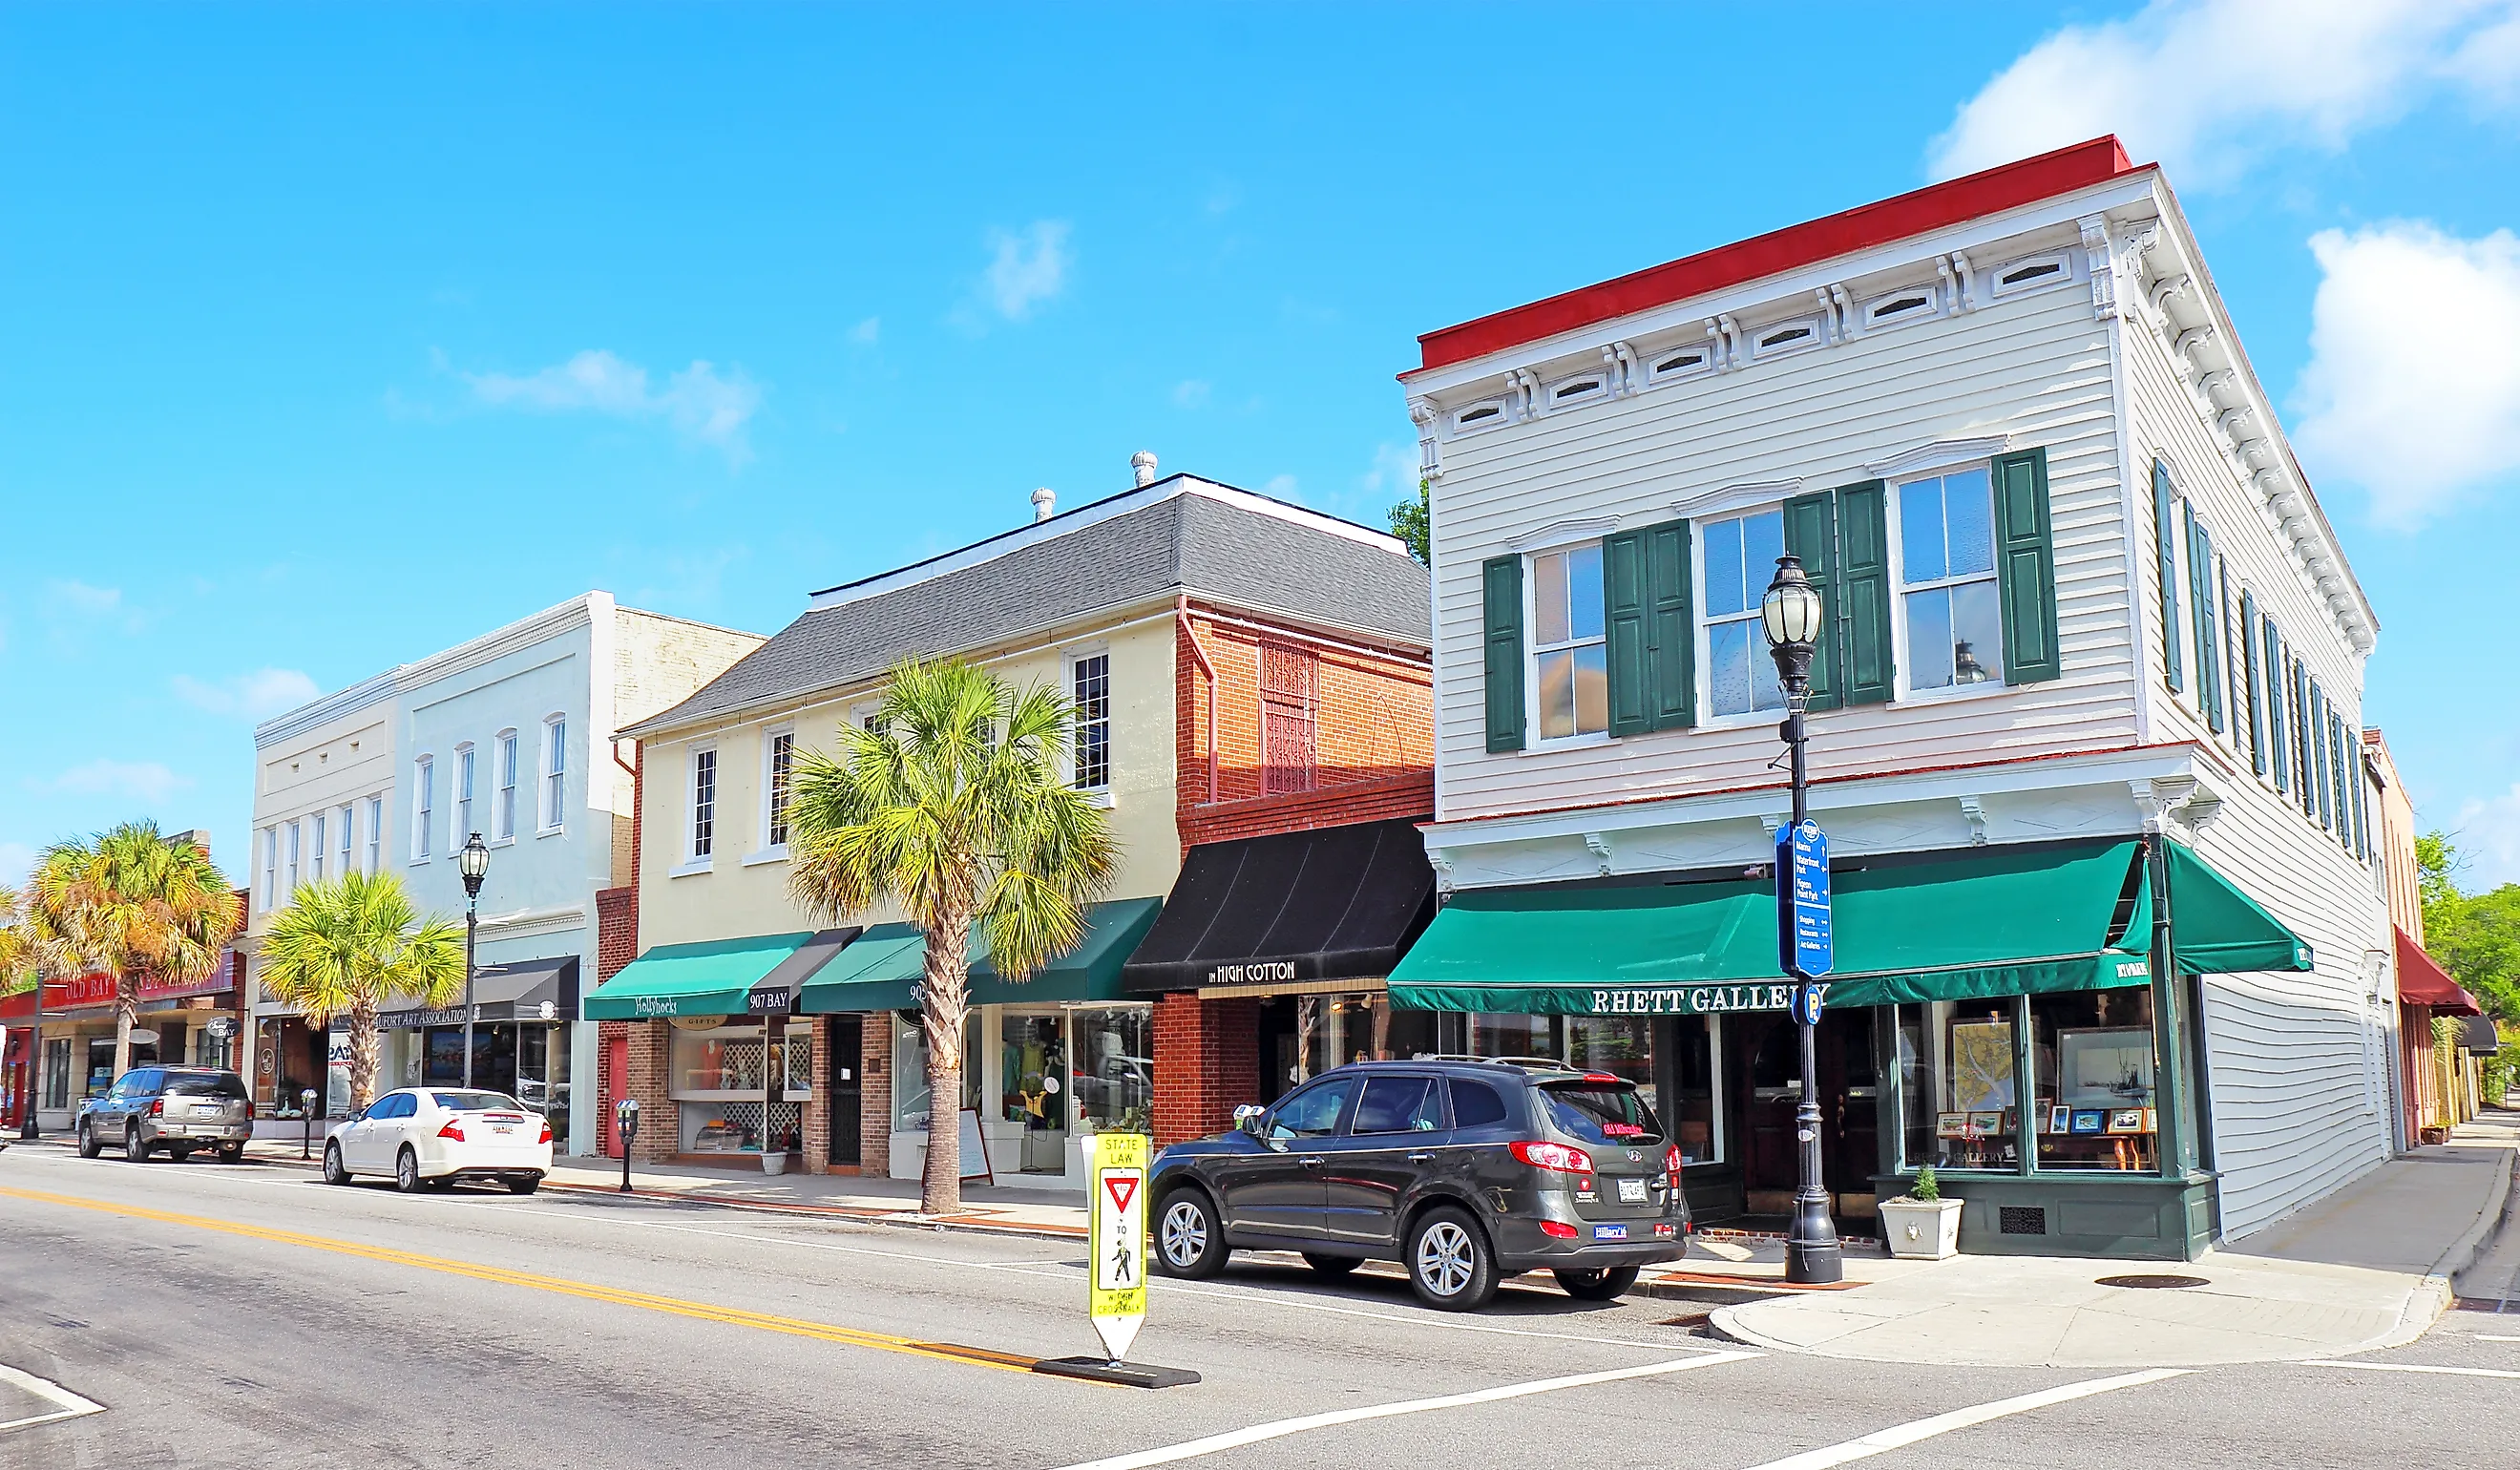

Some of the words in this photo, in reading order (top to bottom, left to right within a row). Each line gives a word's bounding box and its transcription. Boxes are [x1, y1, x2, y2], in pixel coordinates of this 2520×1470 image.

[1796, 864, 1806, 874] Park
[1809, 891, 1818, 901] Park
[1208, 972, 1215, 983] IN
[1217, 965, 1243, 983] HIGH
[1246, 961, 1294, 982] COTTON
[66, 978, 86, 1000] OLD
[90, 976, 111, 997] BAY
[635, 996, 678, 1016] Hollyhocks
[749, 994, 766, 1009] 907
[766, 992, 788, 1008] BAY
[1592, 989, 1685, 1014] RHETT
[403, 1013, 418, 1026] ART
[1105, 1139, 1138, 1150] STATE
[1111, 1153, 1132, 1165] LAW
[1954, 1152, 2004, 1162] GALLERY
[1117, 1226, 1126, 1234] TO
